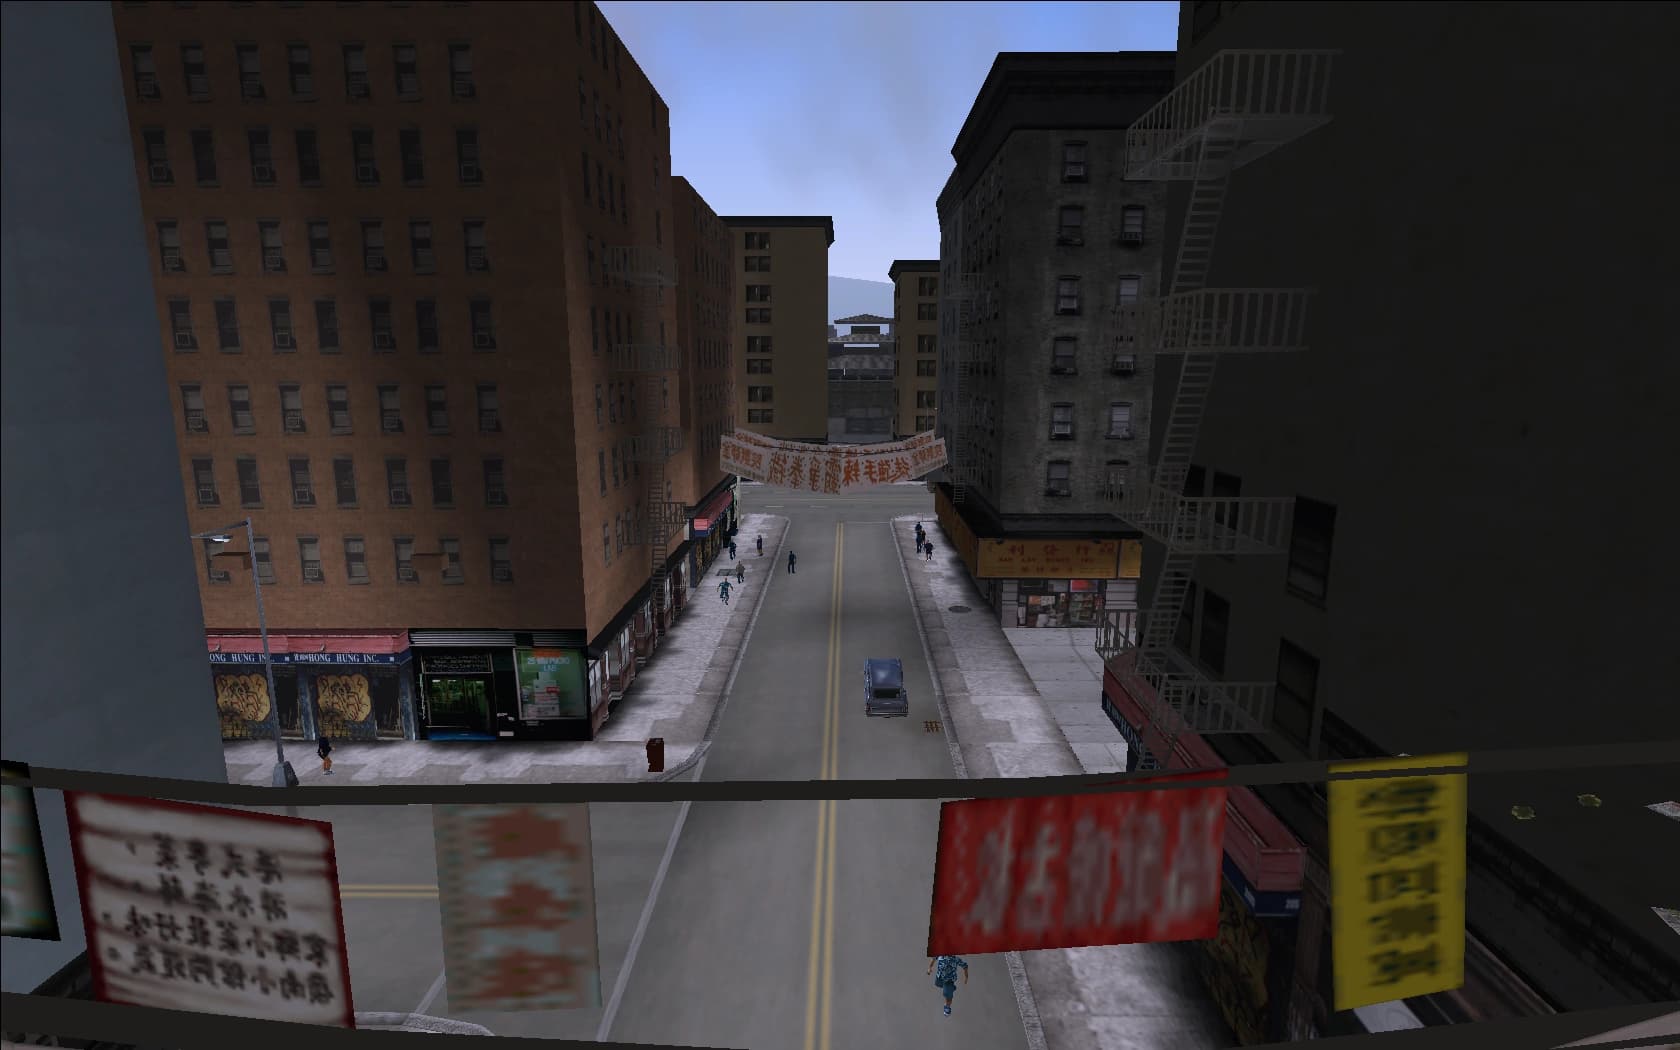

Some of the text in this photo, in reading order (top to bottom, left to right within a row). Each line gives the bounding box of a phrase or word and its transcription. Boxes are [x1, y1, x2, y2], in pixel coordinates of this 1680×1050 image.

[209, 653, 226, 662] ONG
[231, 653, 255, 663] HUNG
[308, 653, 331, 662] HONG
[336, 653, 360, 663] HUNG
[363, 653, 380, 663] INC.
